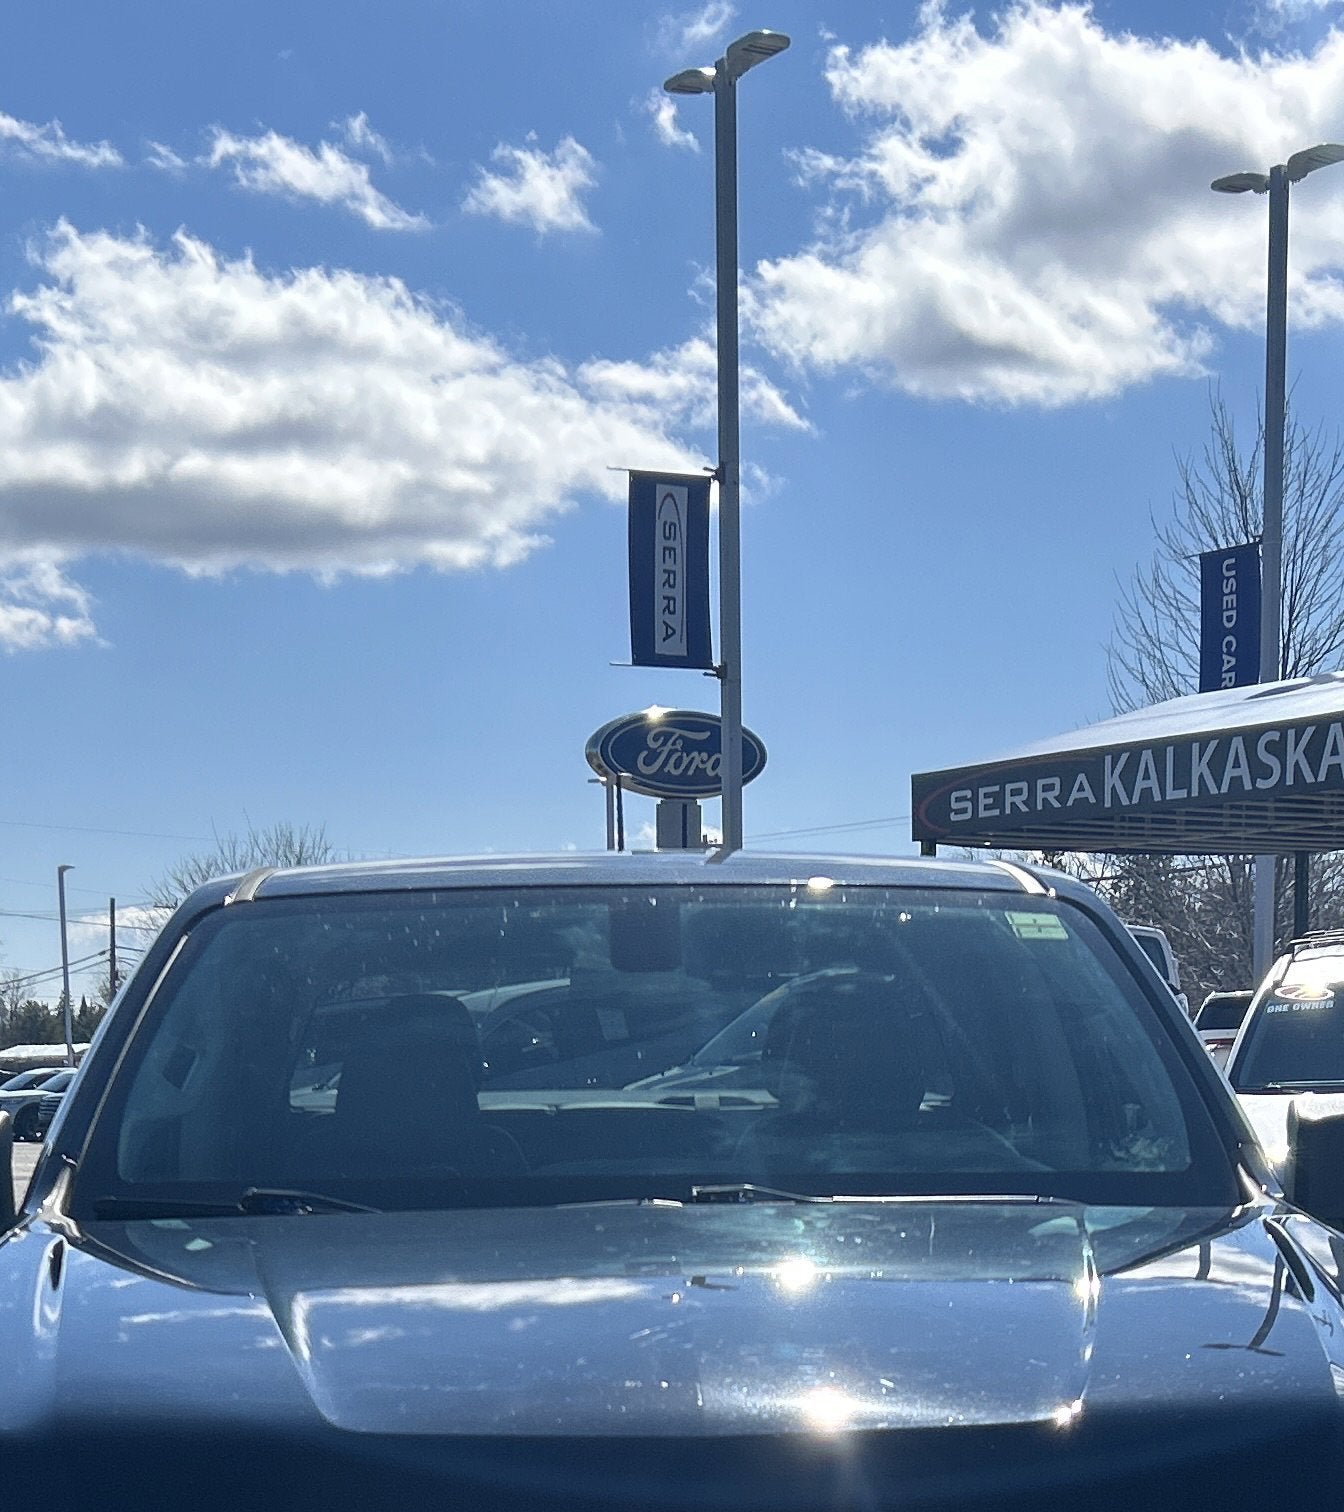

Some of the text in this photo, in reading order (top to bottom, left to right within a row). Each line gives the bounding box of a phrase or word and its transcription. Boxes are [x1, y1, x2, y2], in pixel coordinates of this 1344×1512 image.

[662, 520, 678, 643] SERRA
[1221, 557, 1237, 688] USED CAR
[950, 773, 1096, 822] SERRA
[1266, 1003, 1290, 1014] ONE
